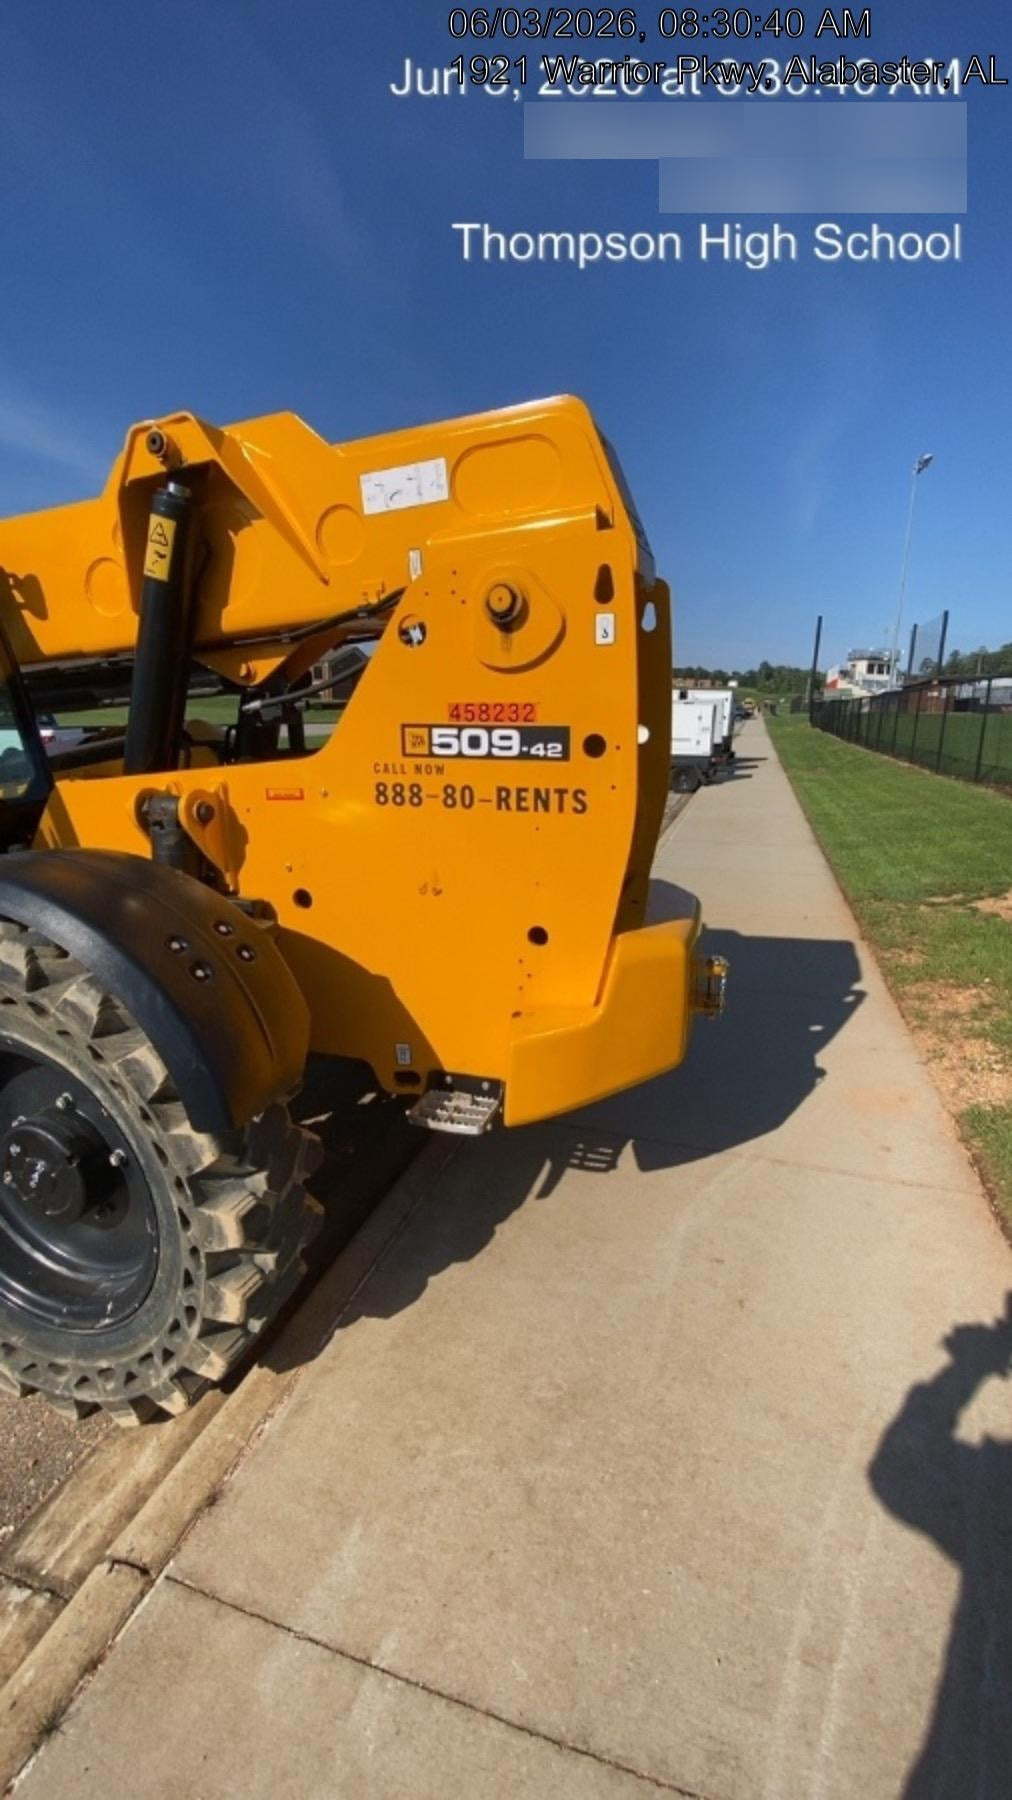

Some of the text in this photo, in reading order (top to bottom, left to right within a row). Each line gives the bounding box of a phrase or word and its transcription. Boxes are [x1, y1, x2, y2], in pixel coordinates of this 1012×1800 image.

[449, 703, 537, 722] 458232
[373, 762, 446, 775] CALL NOW
[374, 782, 588, 814] 888-80-RENTS
